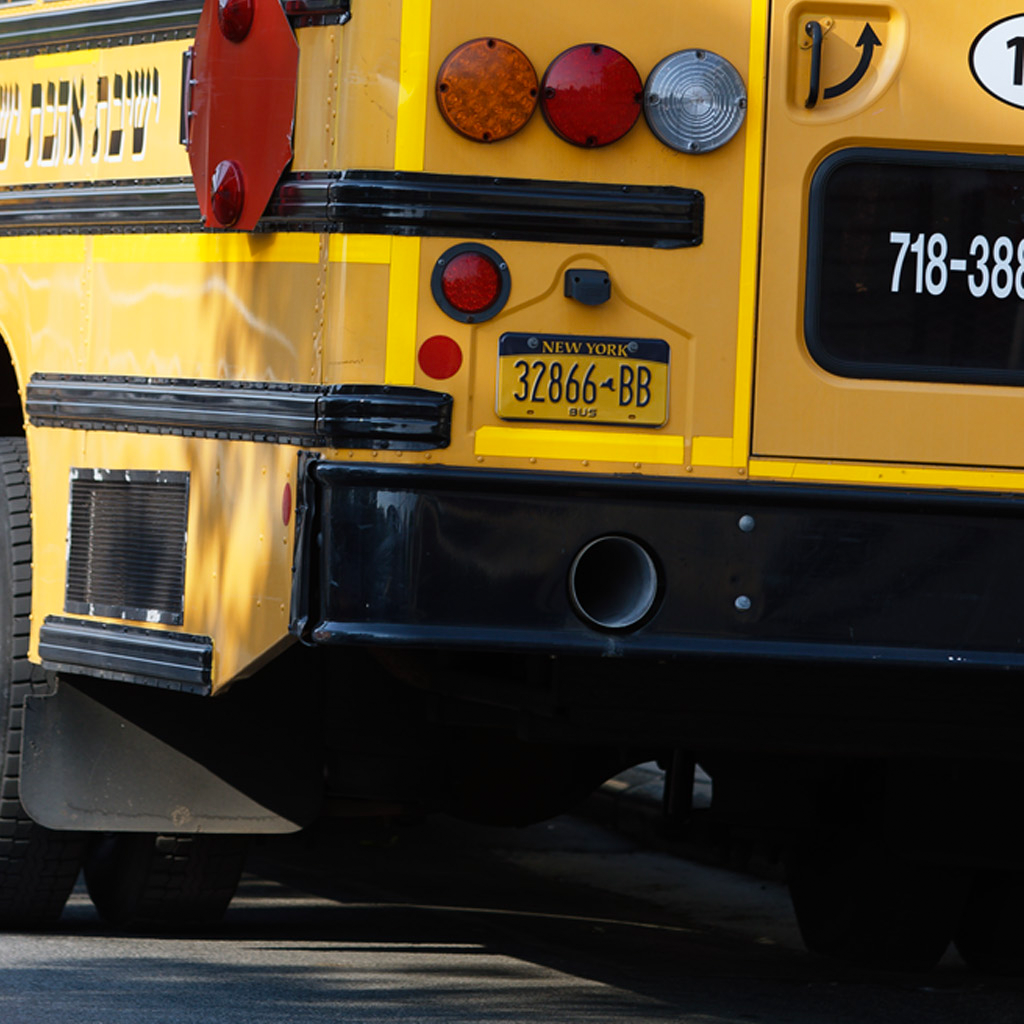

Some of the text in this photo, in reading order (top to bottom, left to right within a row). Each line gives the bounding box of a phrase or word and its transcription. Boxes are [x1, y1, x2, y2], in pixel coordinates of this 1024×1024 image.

[542, 341, 628, 357] NEW YORK
[568, 407, 598, 418] BUS
